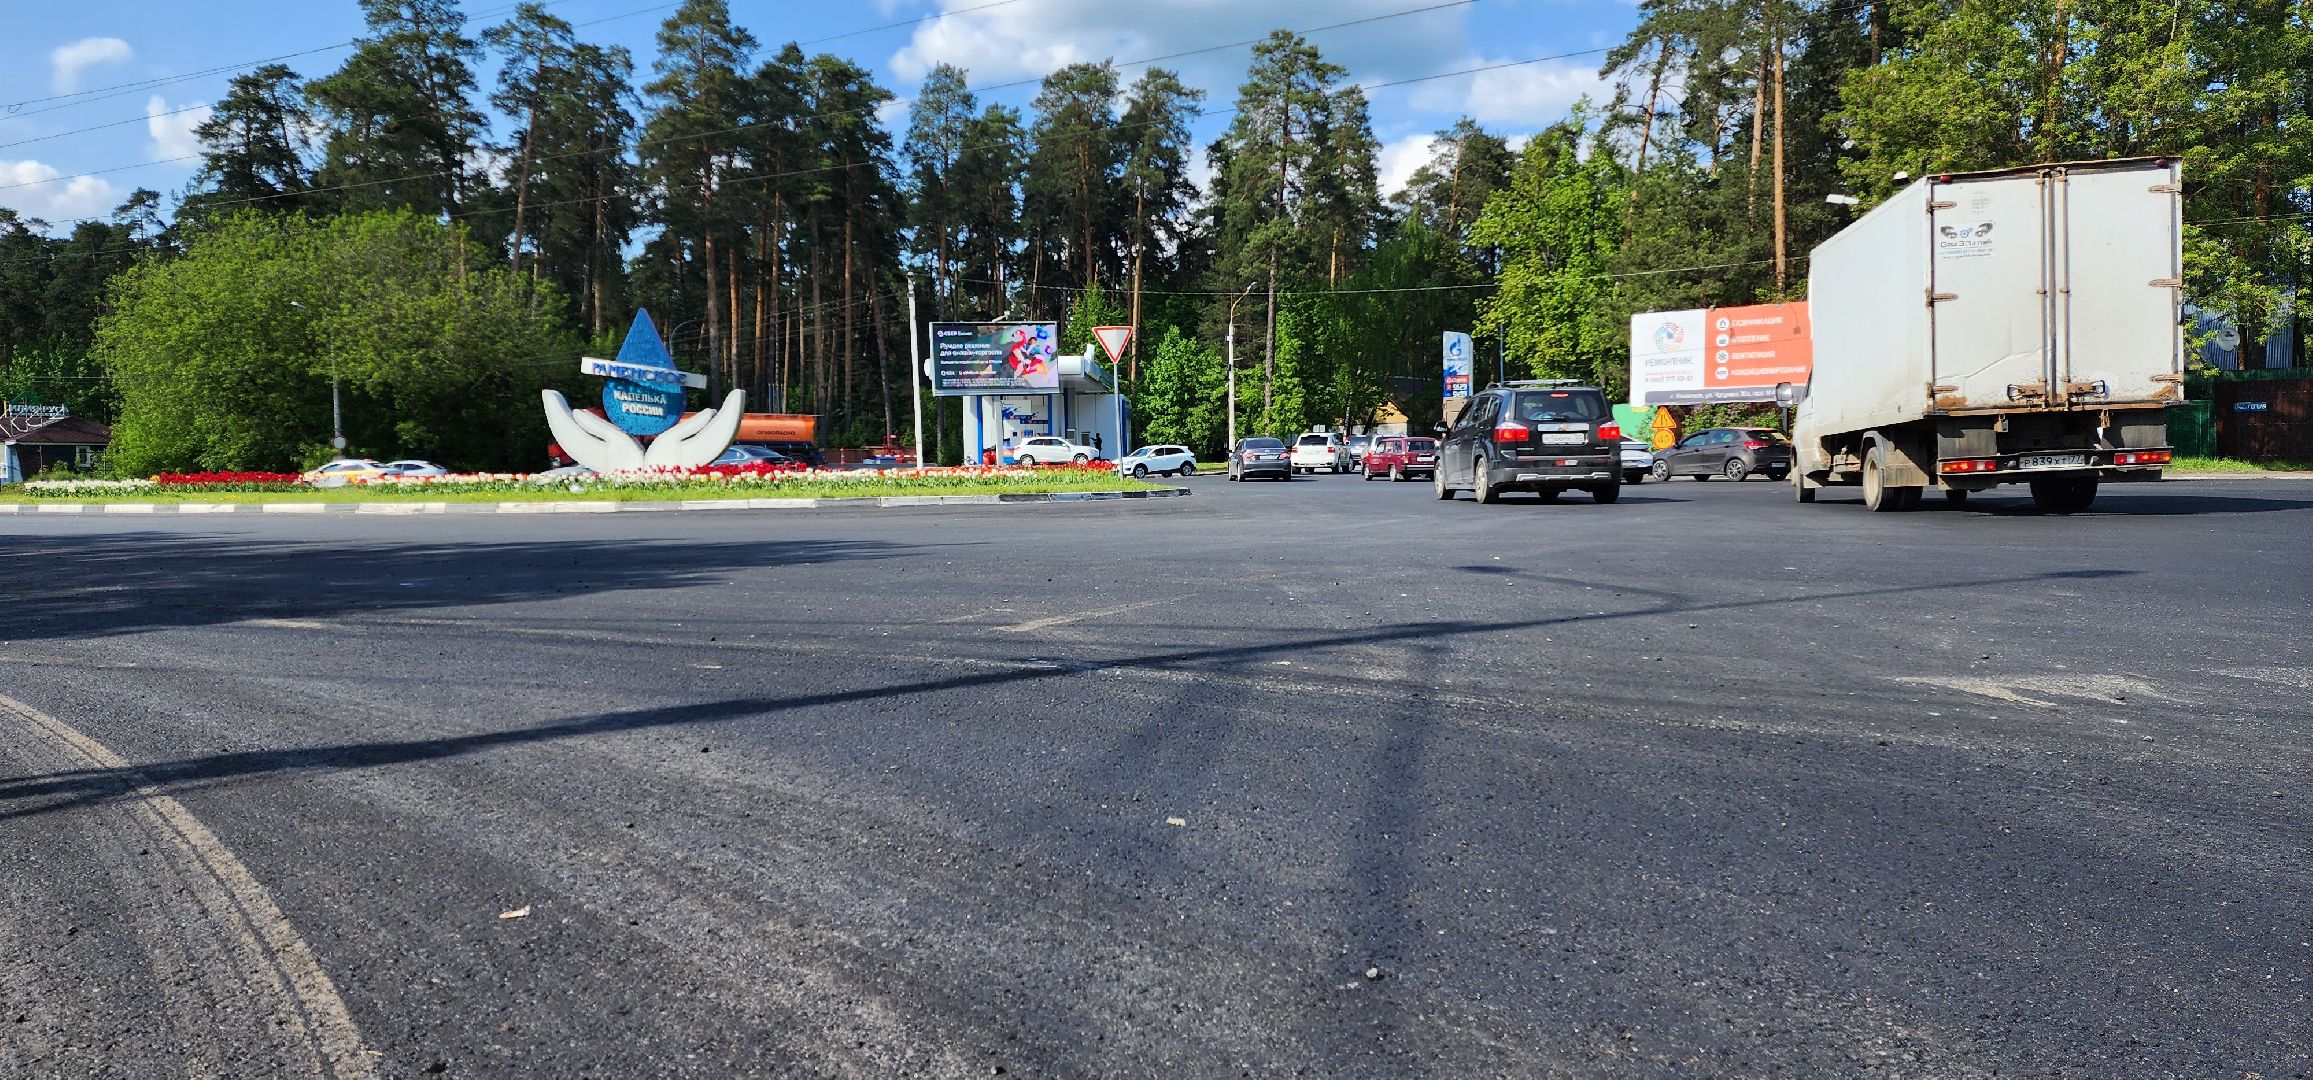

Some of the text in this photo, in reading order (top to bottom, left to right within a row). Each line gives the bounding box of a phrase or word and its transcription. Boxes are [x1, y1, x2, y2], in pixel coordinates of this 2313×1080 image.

[592, 361, 687, 384] РАМЕНСКОЕ
[614, 389, 667, 405] КАПЕЛЬКА
[621, 402, 664, 416] РОССИИ
